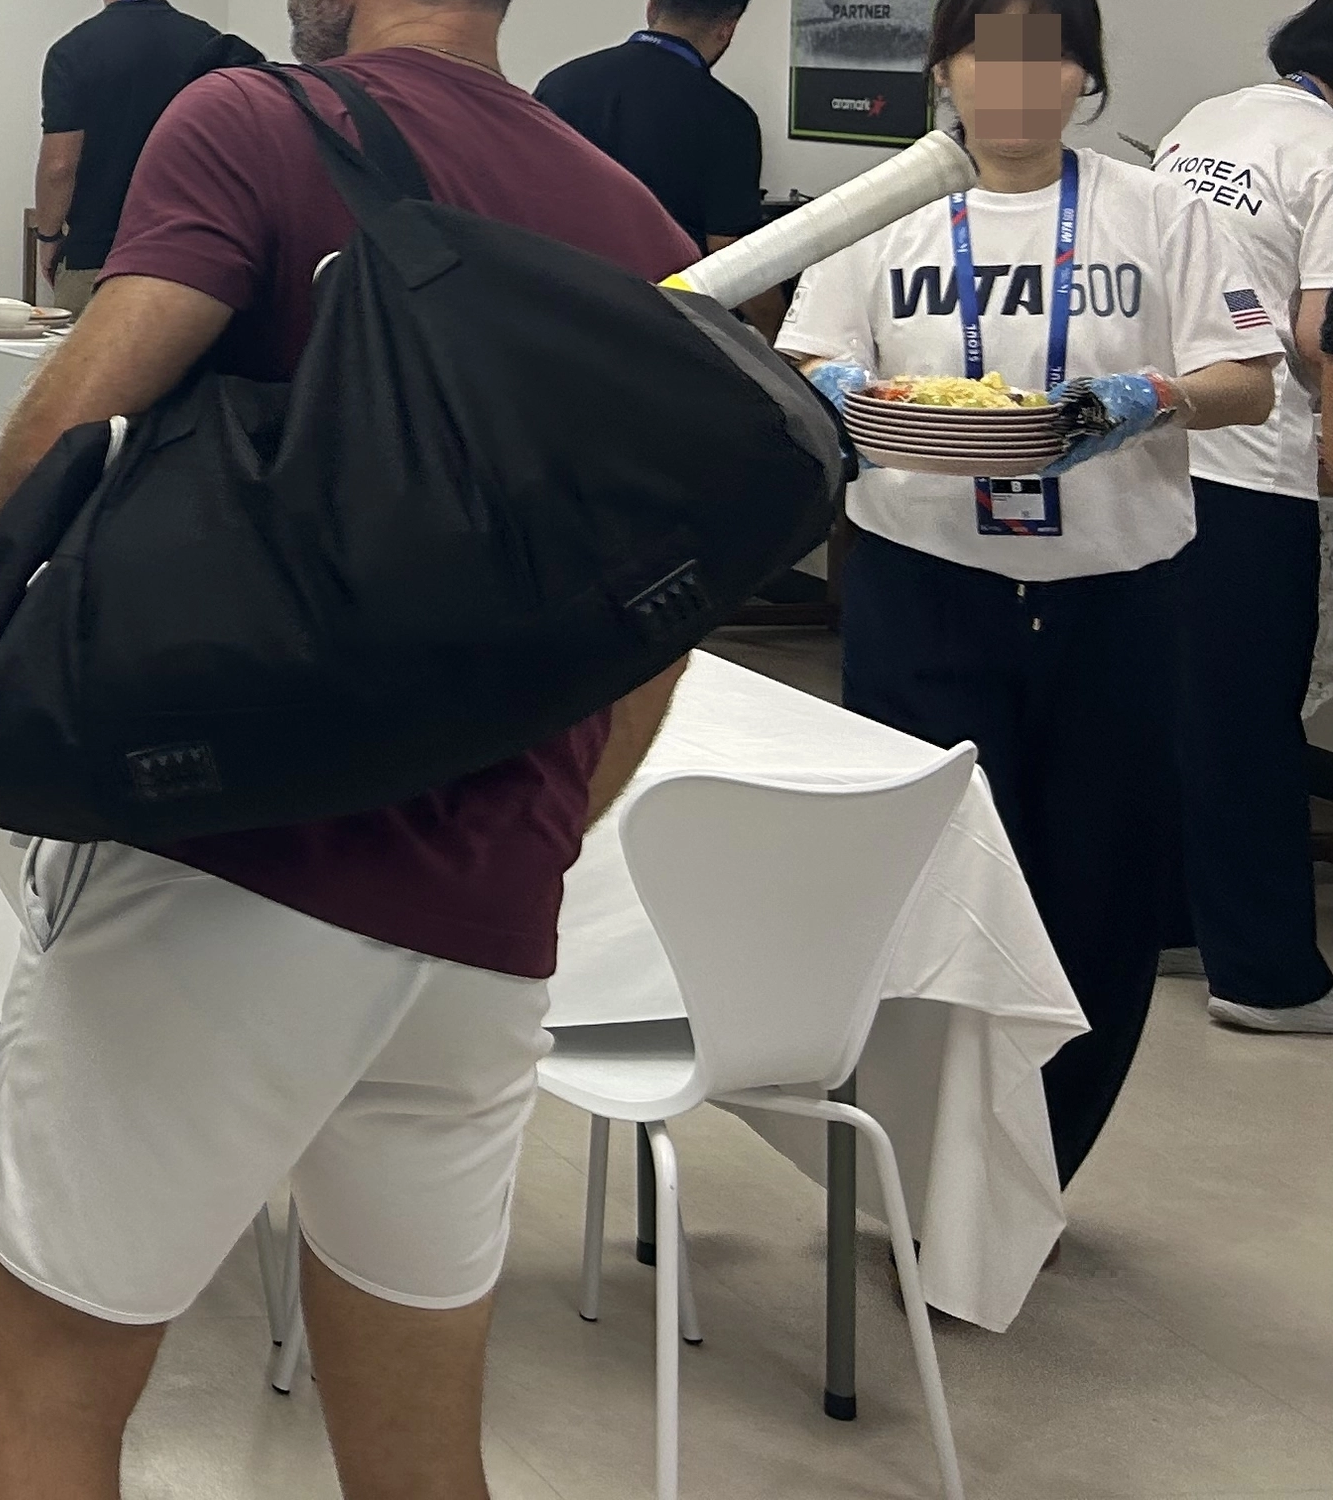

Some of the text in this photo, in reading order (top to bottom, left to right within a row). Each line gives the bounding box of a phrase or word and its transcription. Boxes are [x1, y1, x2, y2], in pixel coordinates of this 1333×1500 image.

[833, 4, 891, 20] PARTNER
[831, 97, 871, 112] aramark
[1170, 157, 1251, 189] KOREA
[1061, 221, 1075, 243] WTA
[889, 263, 1044, 319] WTA
[965, 324, 980, 362] SEOUL
